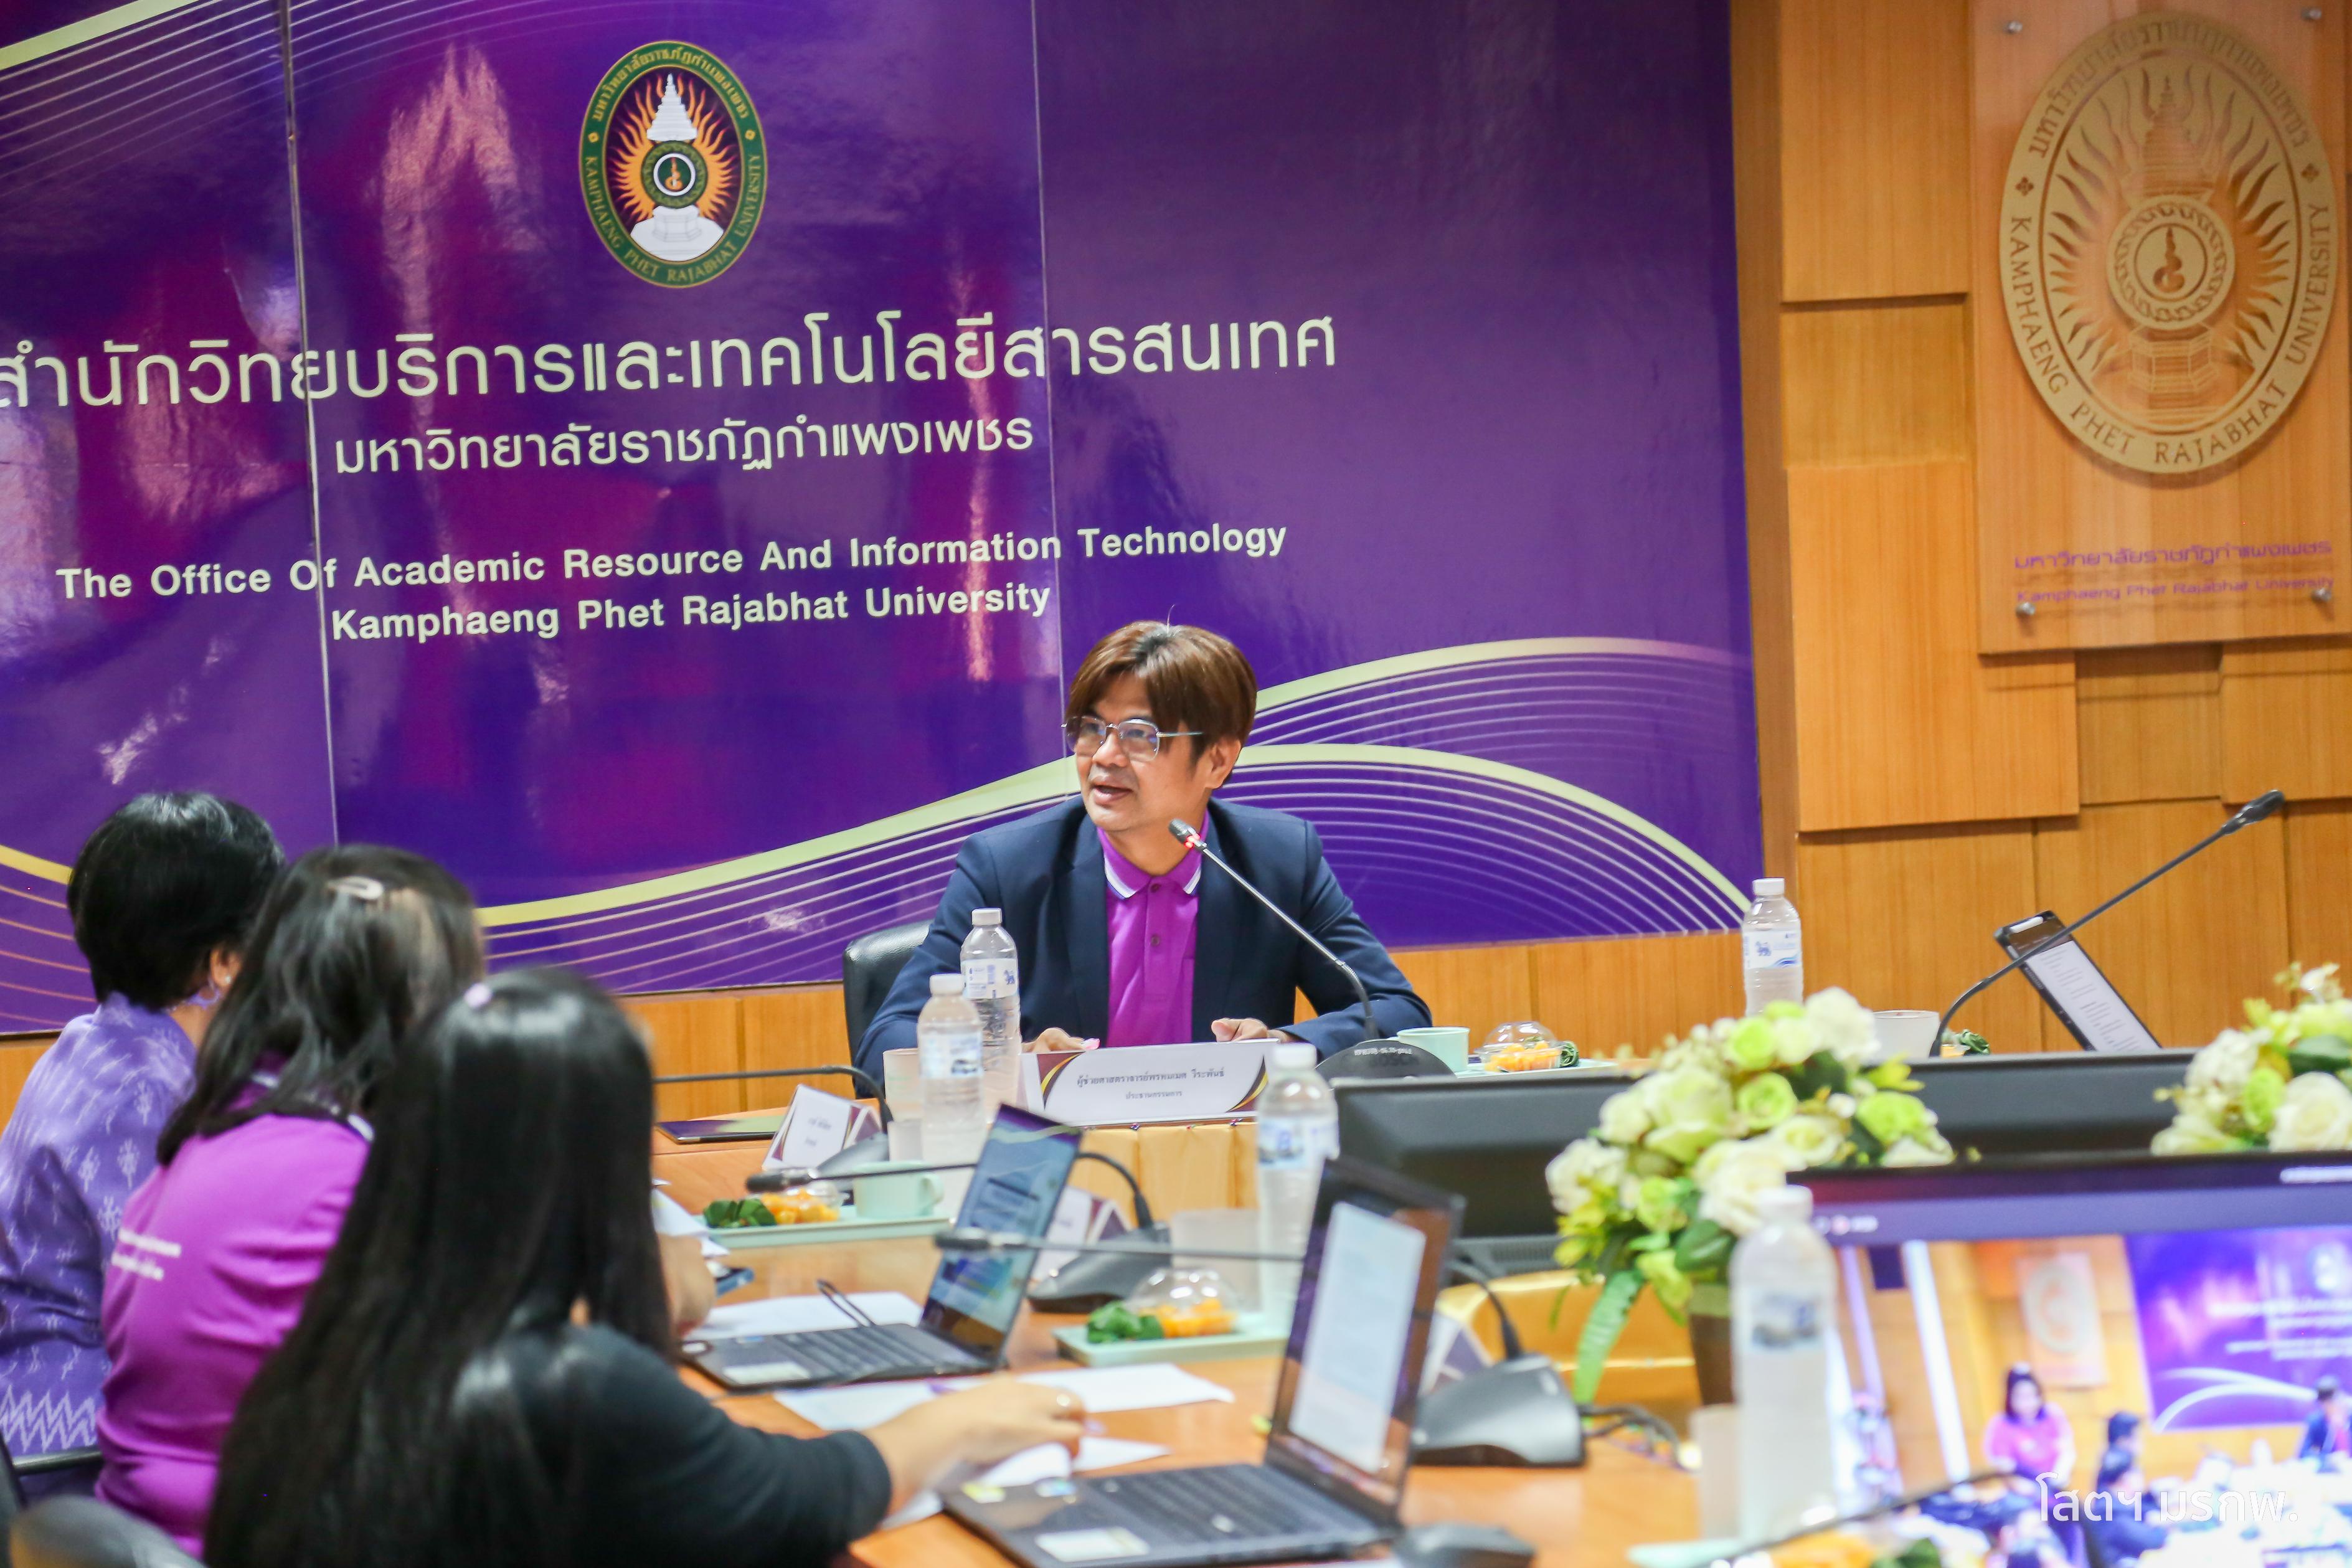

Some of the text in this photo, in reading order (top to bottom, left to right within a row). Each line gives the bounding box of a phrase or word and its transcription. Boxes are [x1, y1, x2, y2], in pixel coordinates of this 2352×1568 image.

[585, 154, 762, 283] KAMPHAENG PHET RAJABHAT UNIVERSITY
[2011, 203, 2330, 466] KAMPHAENG PHET RAJABHAT UNIVERSITY
[335, 413, 1034, 473] มหาวิทยาลัยราชภัฏกำแพงเพชร
[56, 522, 1287, 599] The Office Of Academic Resource And Information Technology
[2127, 584, 2167, 598] Phet
[332, 583, 1051, 644] Kamphaeng Phet Rajabhat University
